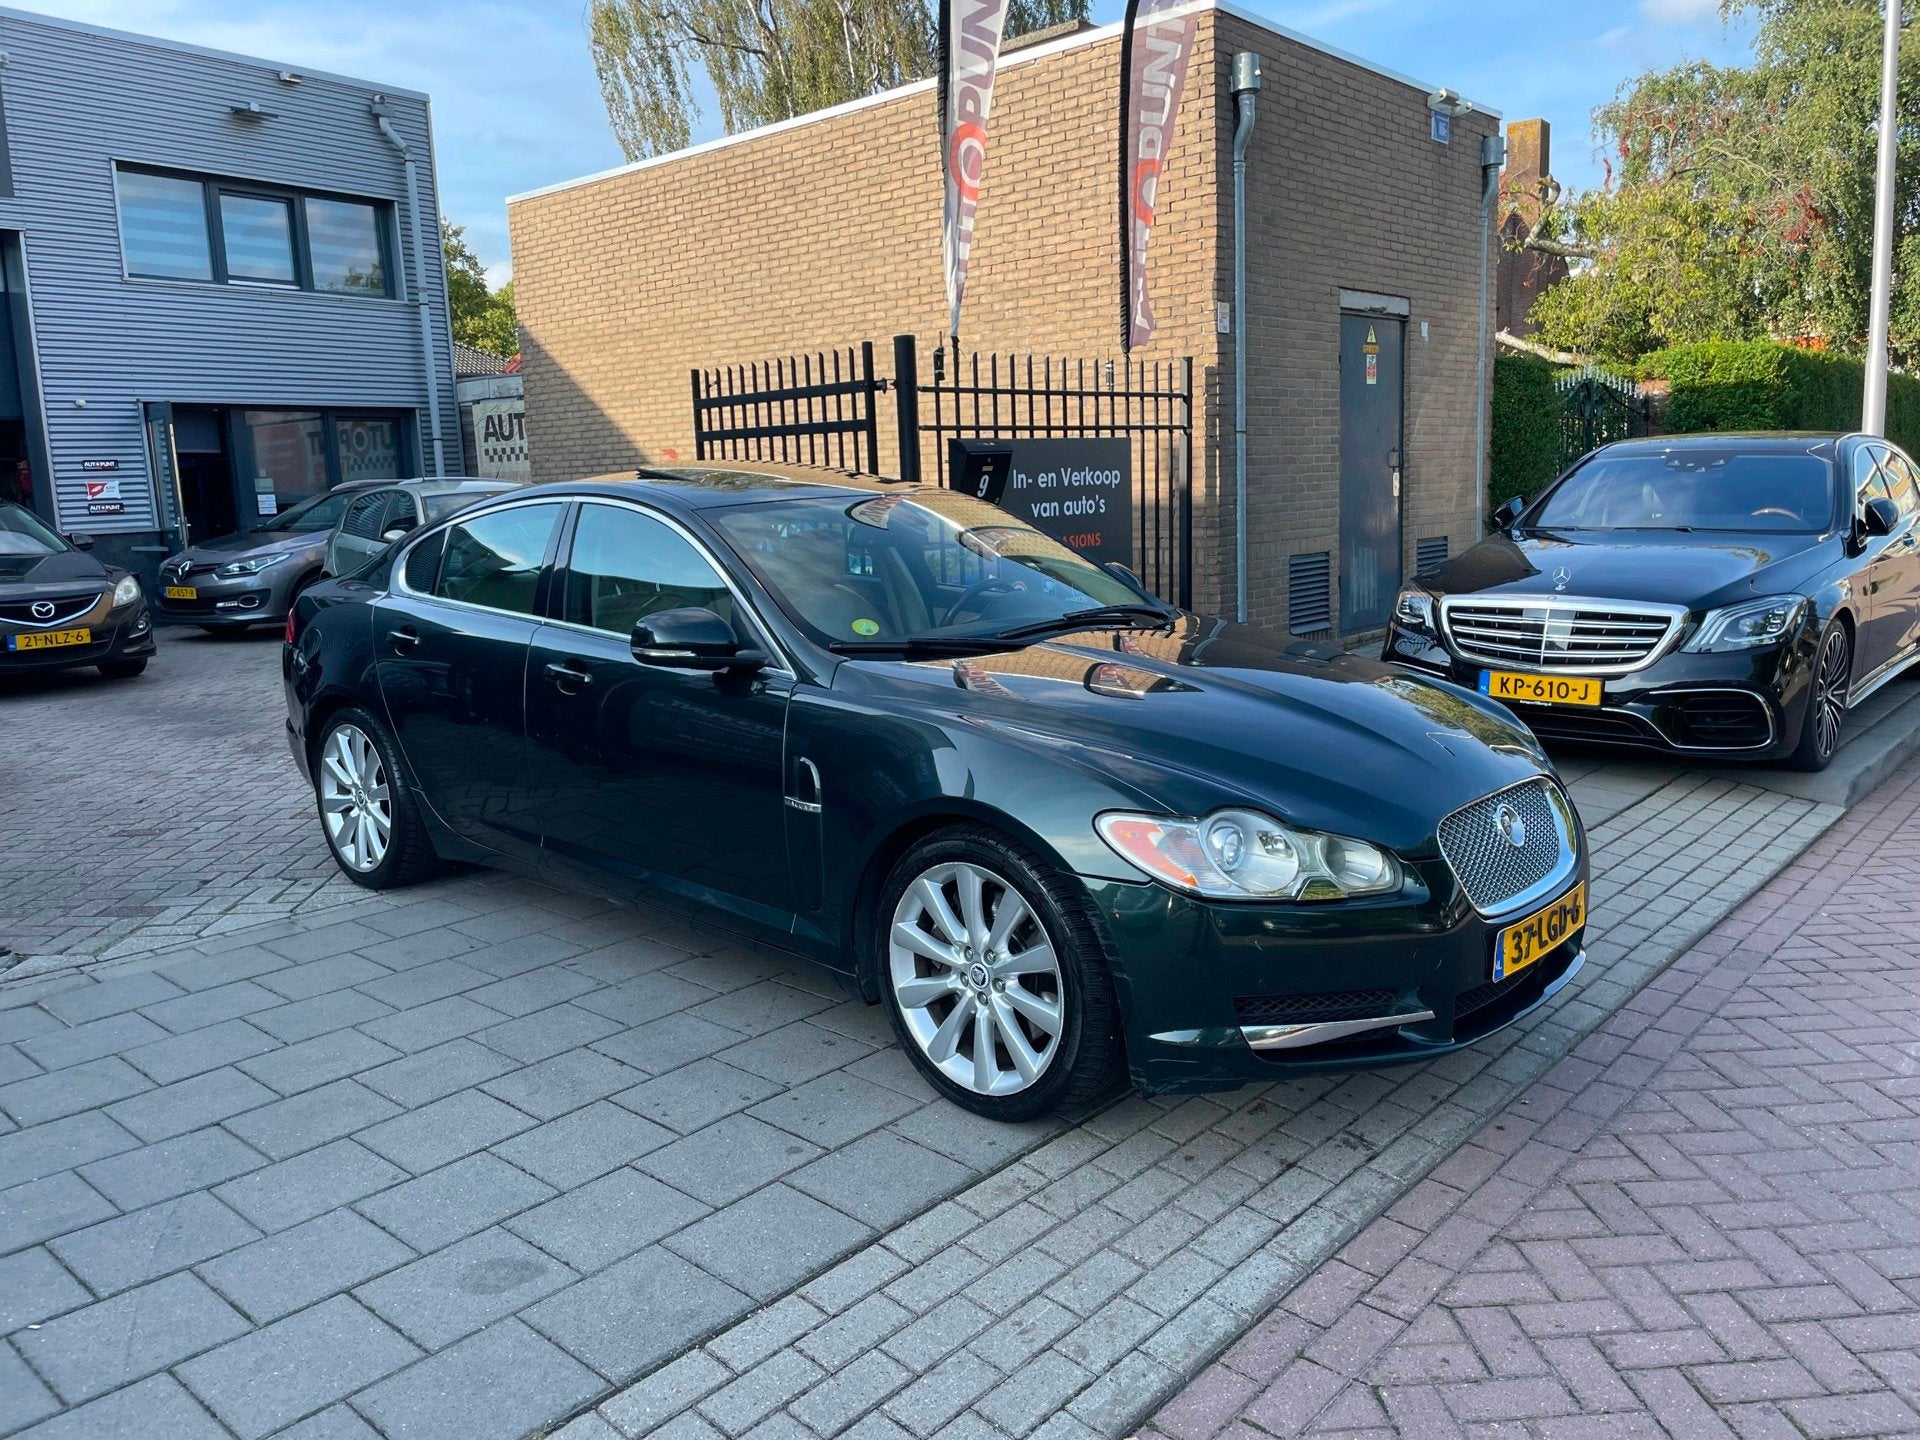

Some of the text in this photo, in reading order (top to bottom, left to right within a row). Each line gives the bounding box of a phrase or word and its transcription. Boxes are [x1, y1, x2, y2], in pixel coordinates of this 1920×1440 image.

[484, 412, 526, 443] AUT
[977, 474, 990, 498] 9
[1013, 466, 1121, 489] In- en Verkoop
[1031, 494, 1106, 518] van auto's
[24, 632, 84, 648] 21-NLZ-6
[1500, 676, 1589, 700] KP-610-J
[1511, 893, 1580, 965] 37-LGD-6
